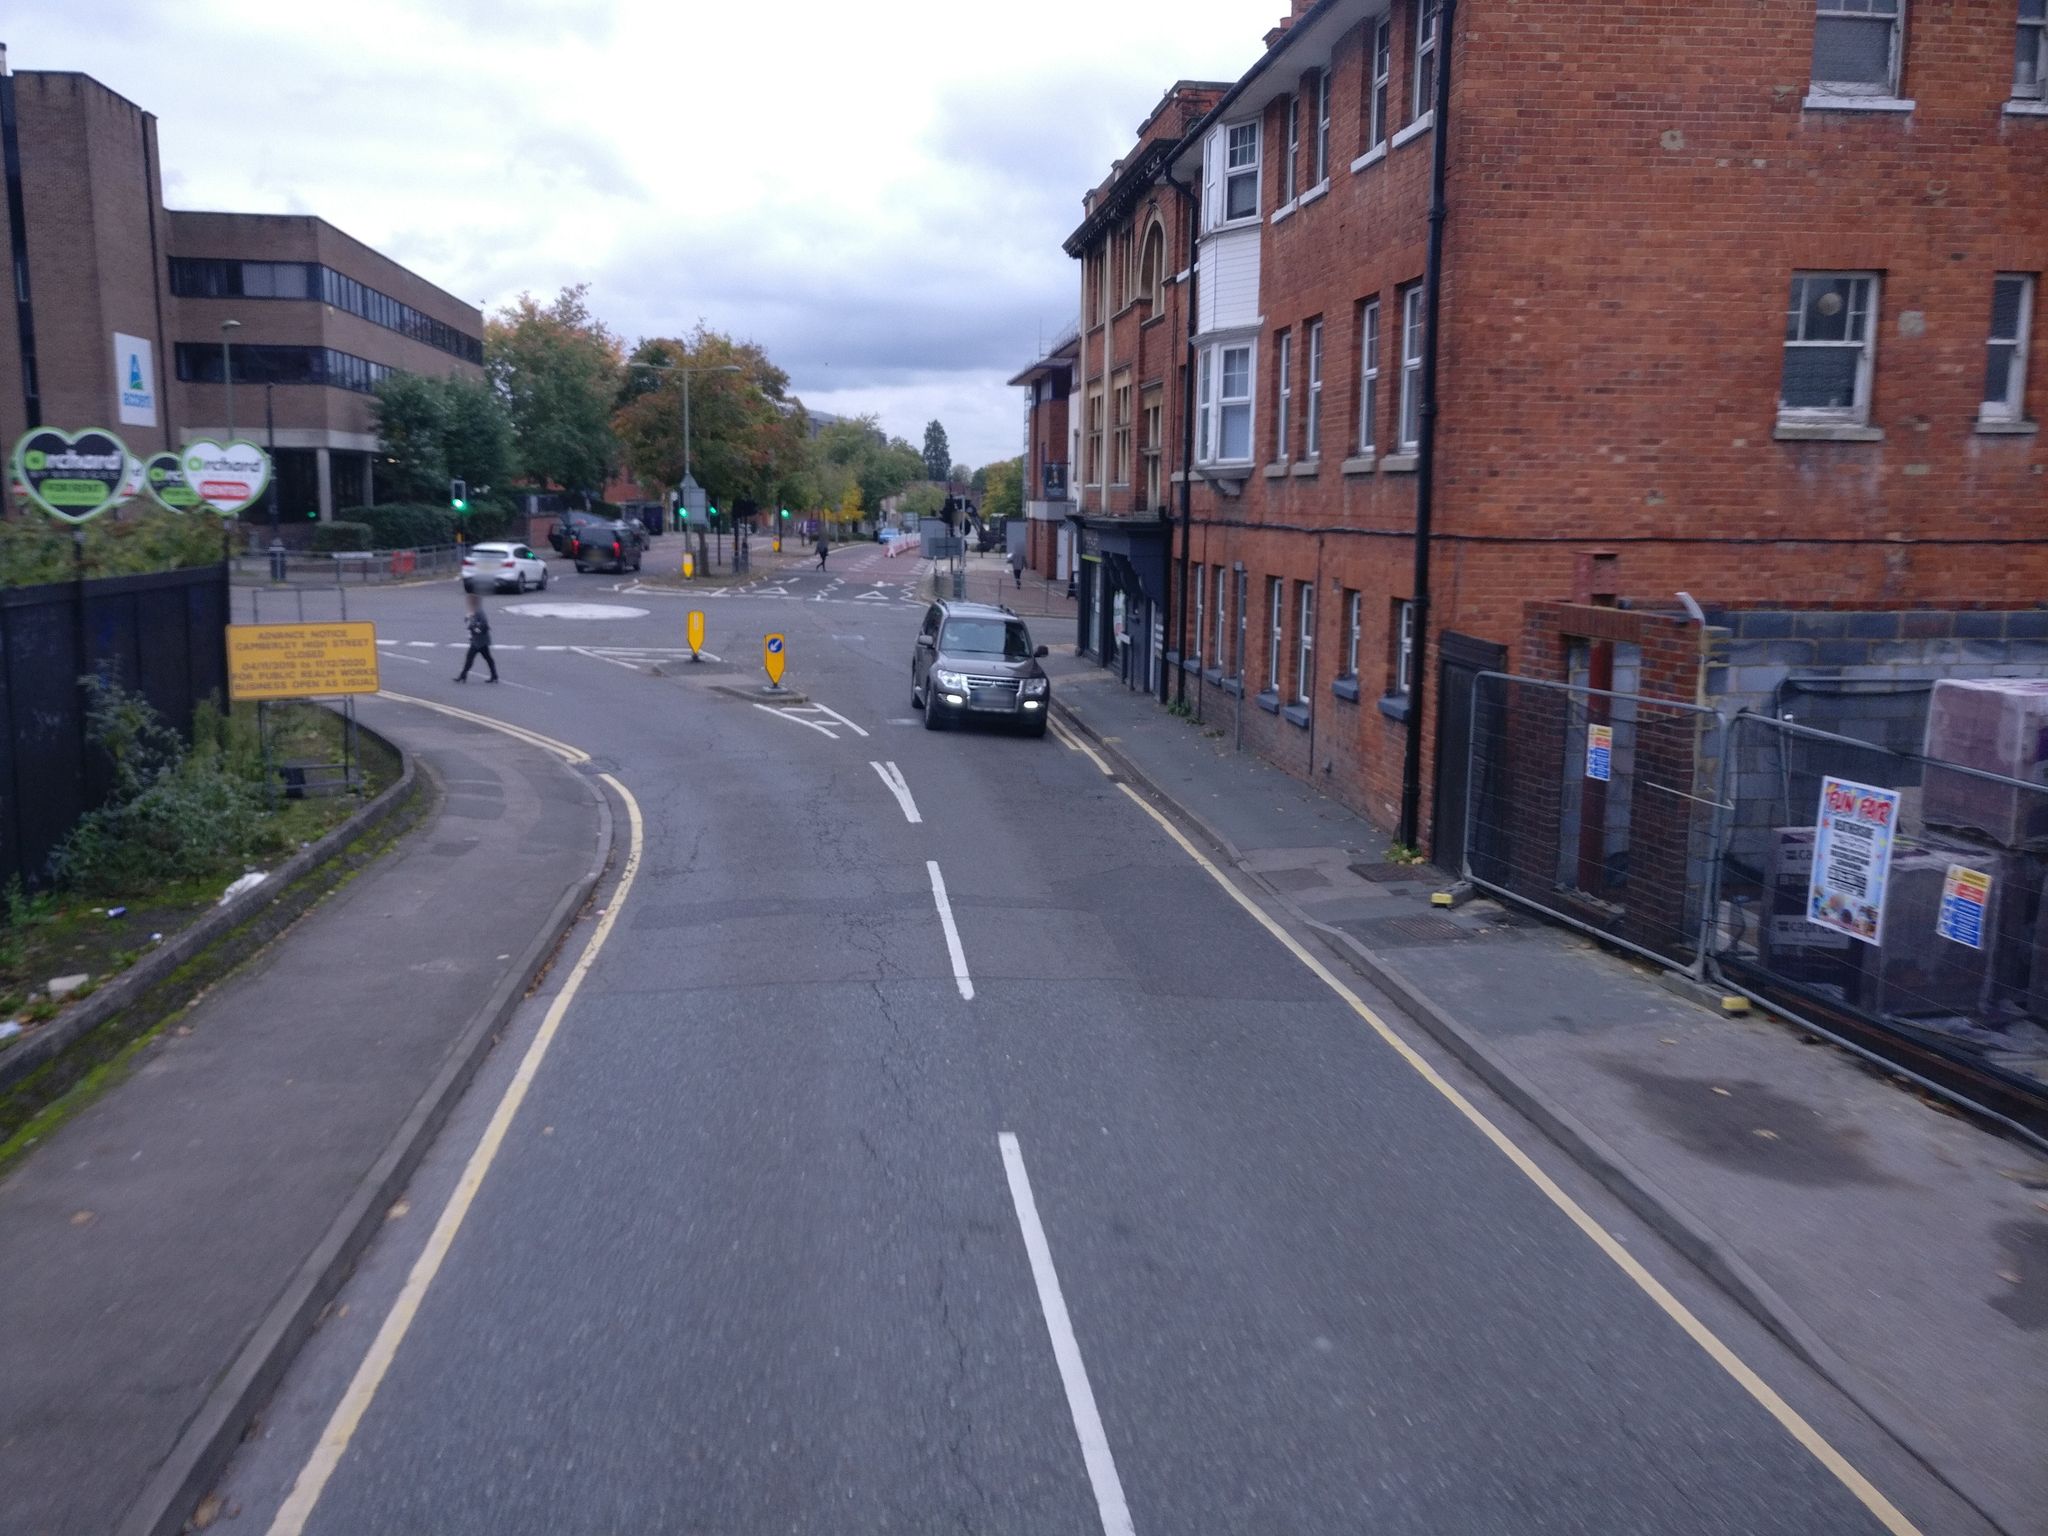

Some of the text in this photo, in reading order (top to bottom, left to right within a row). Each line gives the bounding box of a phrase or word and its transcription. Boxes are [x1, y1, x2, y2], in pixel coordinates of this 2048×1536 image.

[258, 632, 305, 640] ADVANCE
[236, 642, 297, 650] CAMBERLEY
[332, 640, 369, 648] STREET
[284, 651, 325, 659] CLOSED
[230, 673, 253, 681] FOR
[301, 670, 336, 678] REALM
[340, 668, 377, 676] WORKS
[234, 682, 287, 690] BUSINESS
[343, 678, 377, 686] USUAL
[1829, 791, 1892, 824] FUN FAIR
